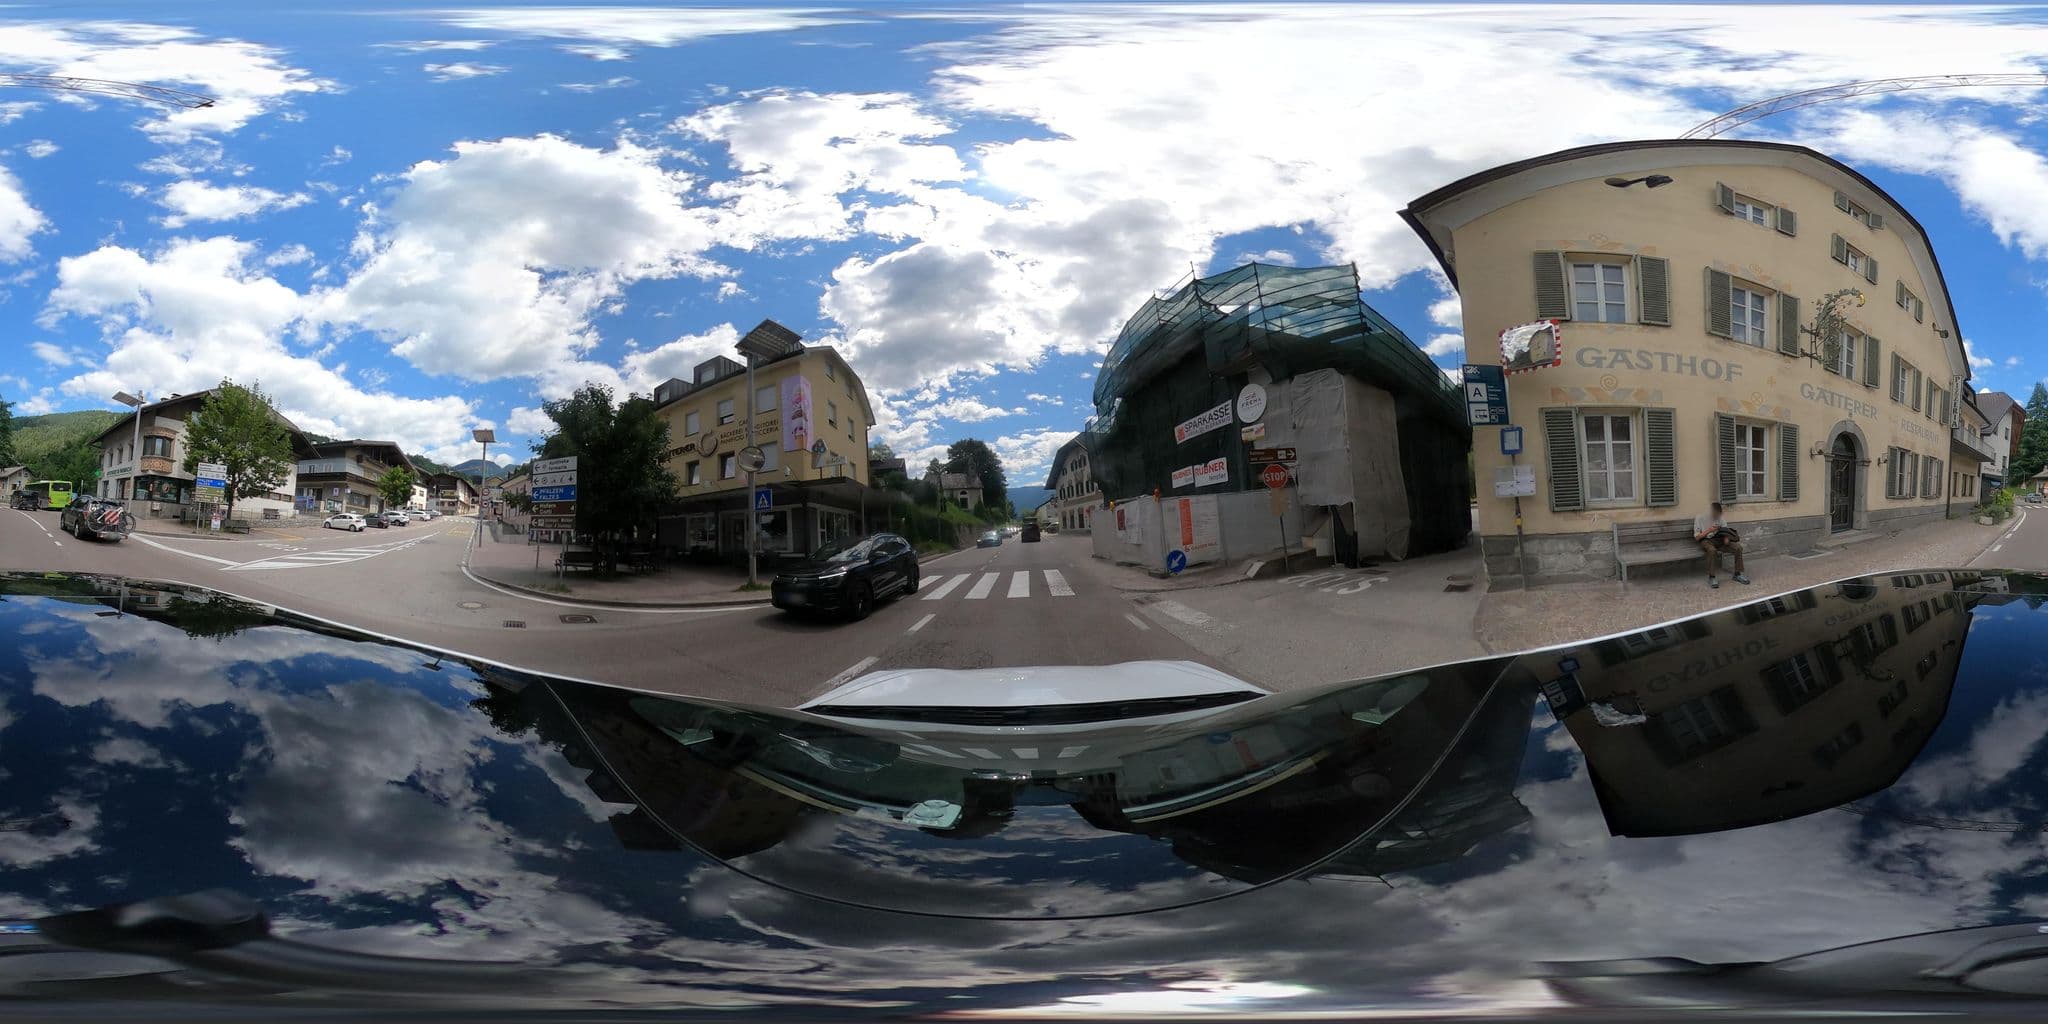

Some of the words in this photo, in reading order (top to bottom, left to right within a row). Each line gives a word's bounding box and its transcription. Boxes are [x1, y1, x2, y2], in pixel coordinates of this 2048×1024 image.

[1575, 347, 1744, 383] GASTHOF
[1473, 387, 1483, 398] A
[1800, 383, 1878, 420] GATTERER
[1184, 403, 1231, 433] SPARKASSE
[1194, 461, 1225, 477] RUBNER
[1264, 471, 1286, 483] STOP
